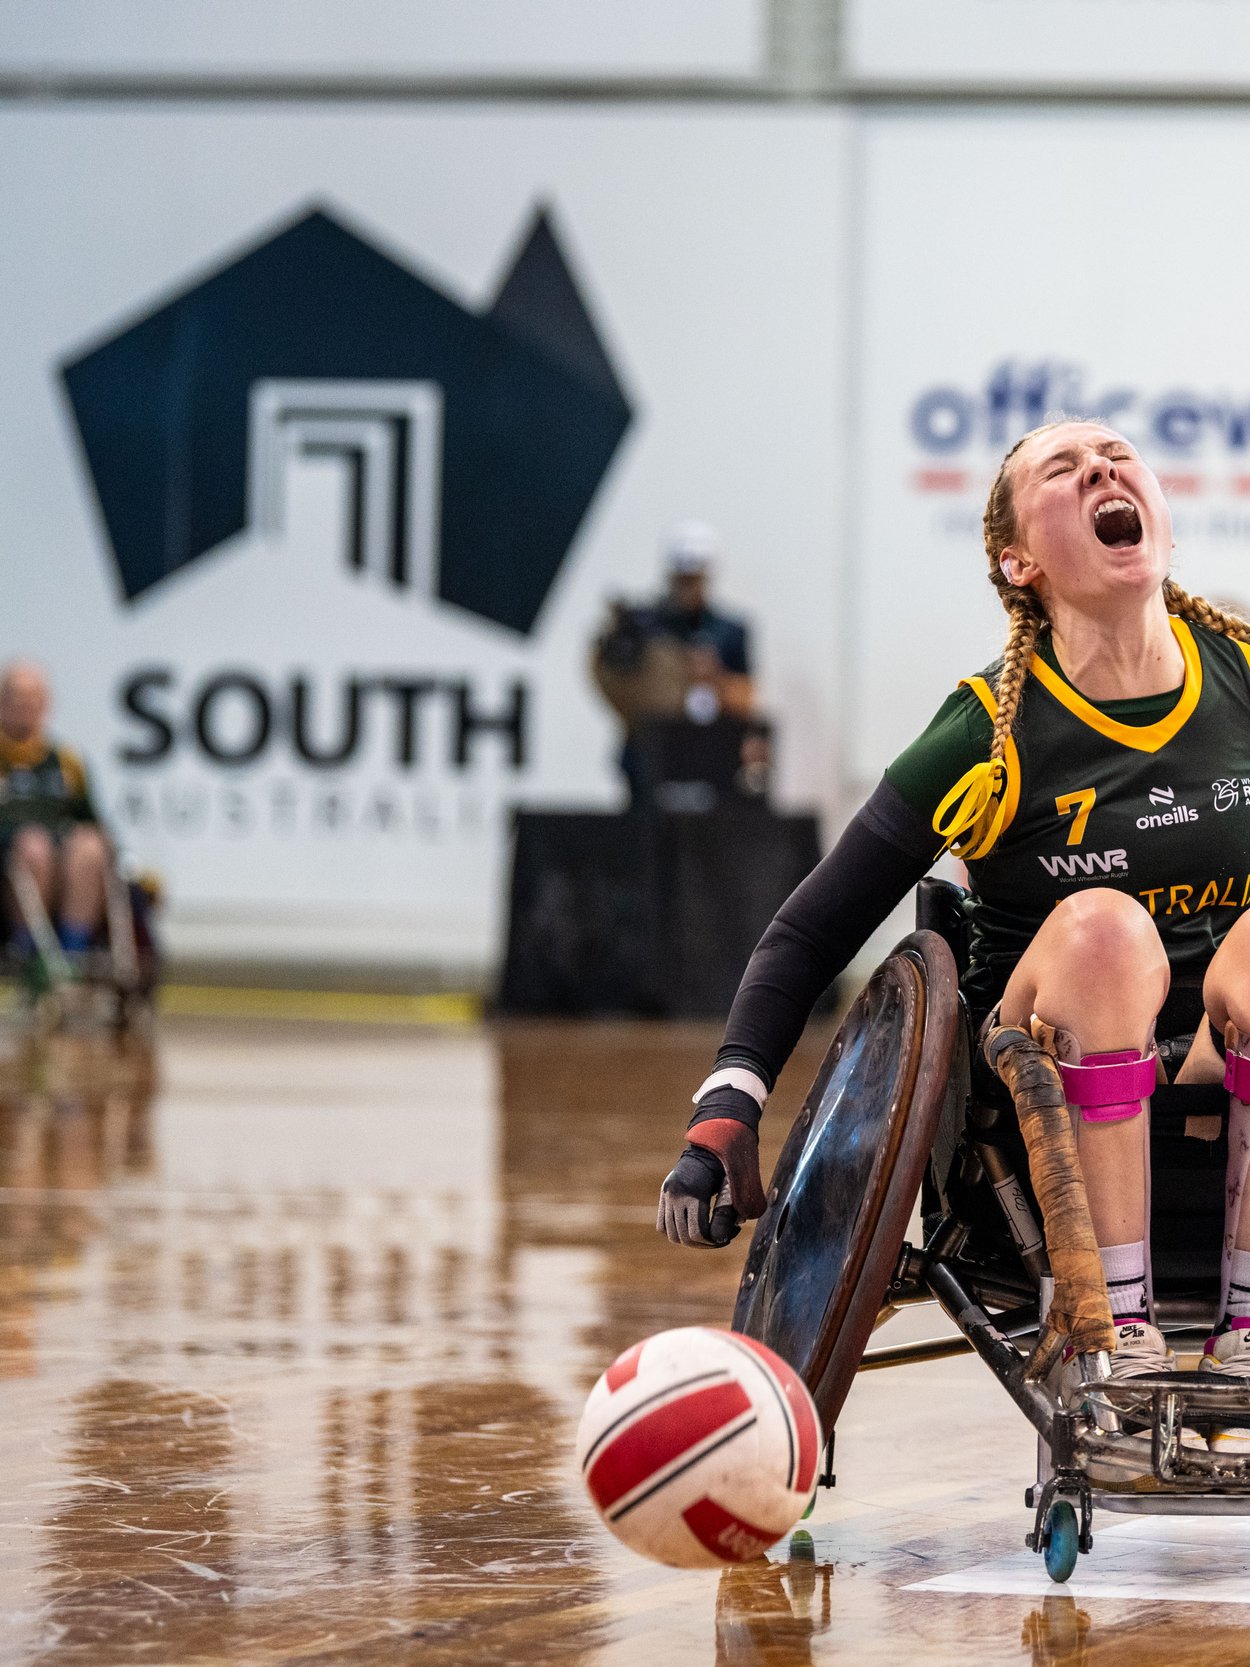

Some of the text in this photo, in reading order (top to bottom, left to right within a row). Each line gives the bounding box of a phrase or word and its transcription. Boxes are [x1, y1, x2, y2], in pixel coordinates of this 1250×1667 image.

[118, 666, 528, 769] SOUTH
[118, 778, 500, 838] AUSTRALI
[1055, 787, 1097, 846] 7
[1132, 1330, 1145, 1338] AIR
